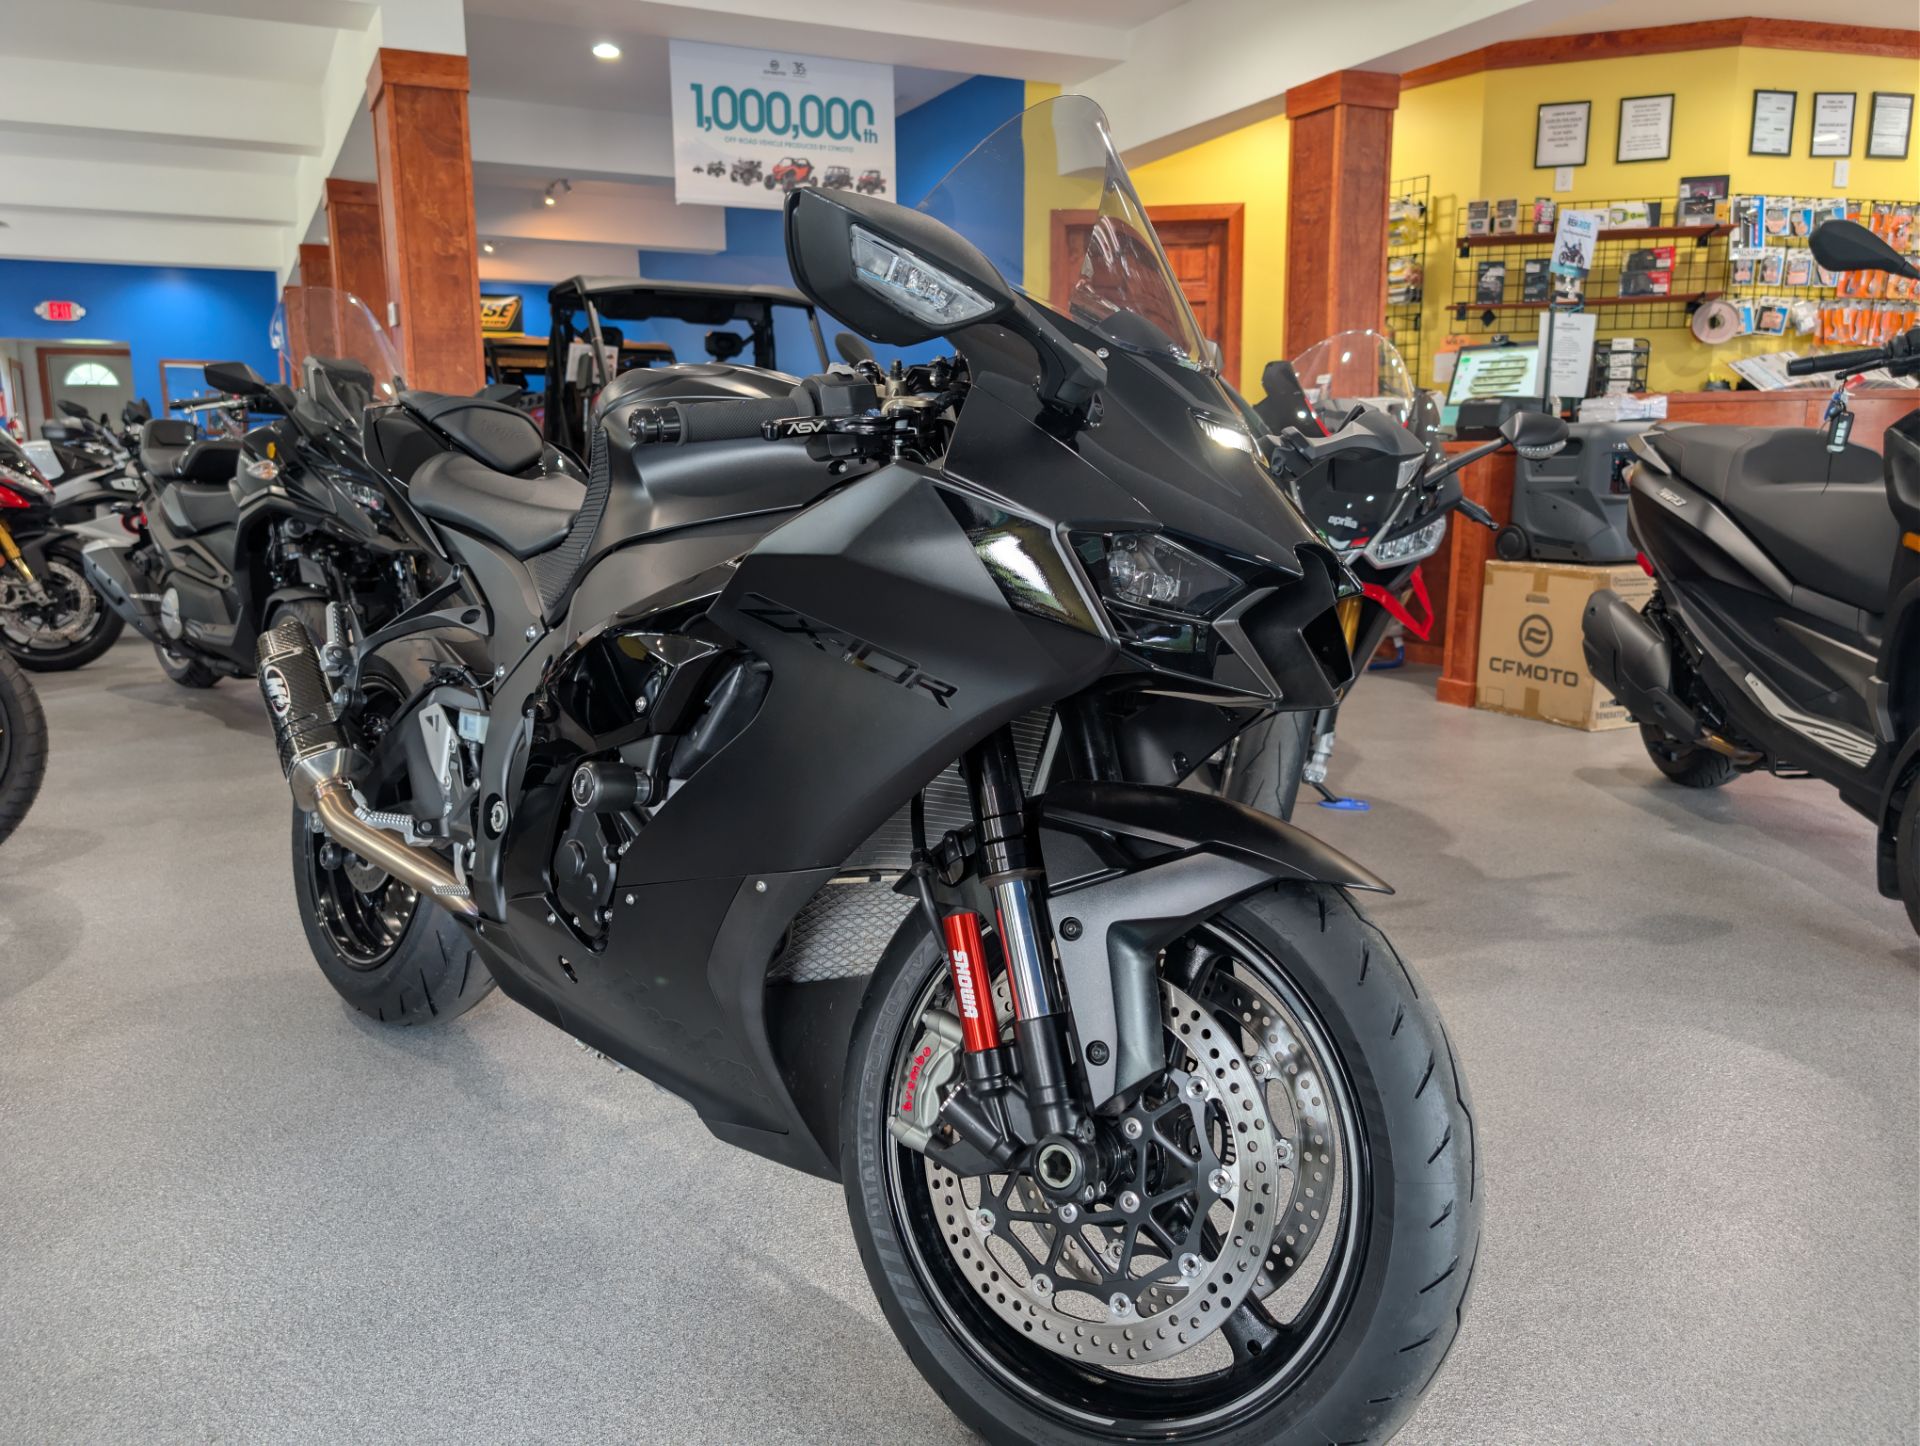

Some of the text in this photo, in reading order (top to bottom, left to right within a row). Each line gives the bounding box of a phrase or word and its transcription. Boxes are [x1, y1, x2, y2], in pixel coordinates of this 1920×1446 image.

[50, 302, 72, 319] EXIT
[787, 420, 825, 435] ASV
[1328, 515, 1359, 529] aprilia
[738, 592, 959, 710] ZX-10R
[1489, 656, 1579, 688] CFMOTO
[953, 949, 979, 1019] SHOWA
[901, 1046, 932, 1112] brembo
[859, 1101, 884, 1218] DIABLO
